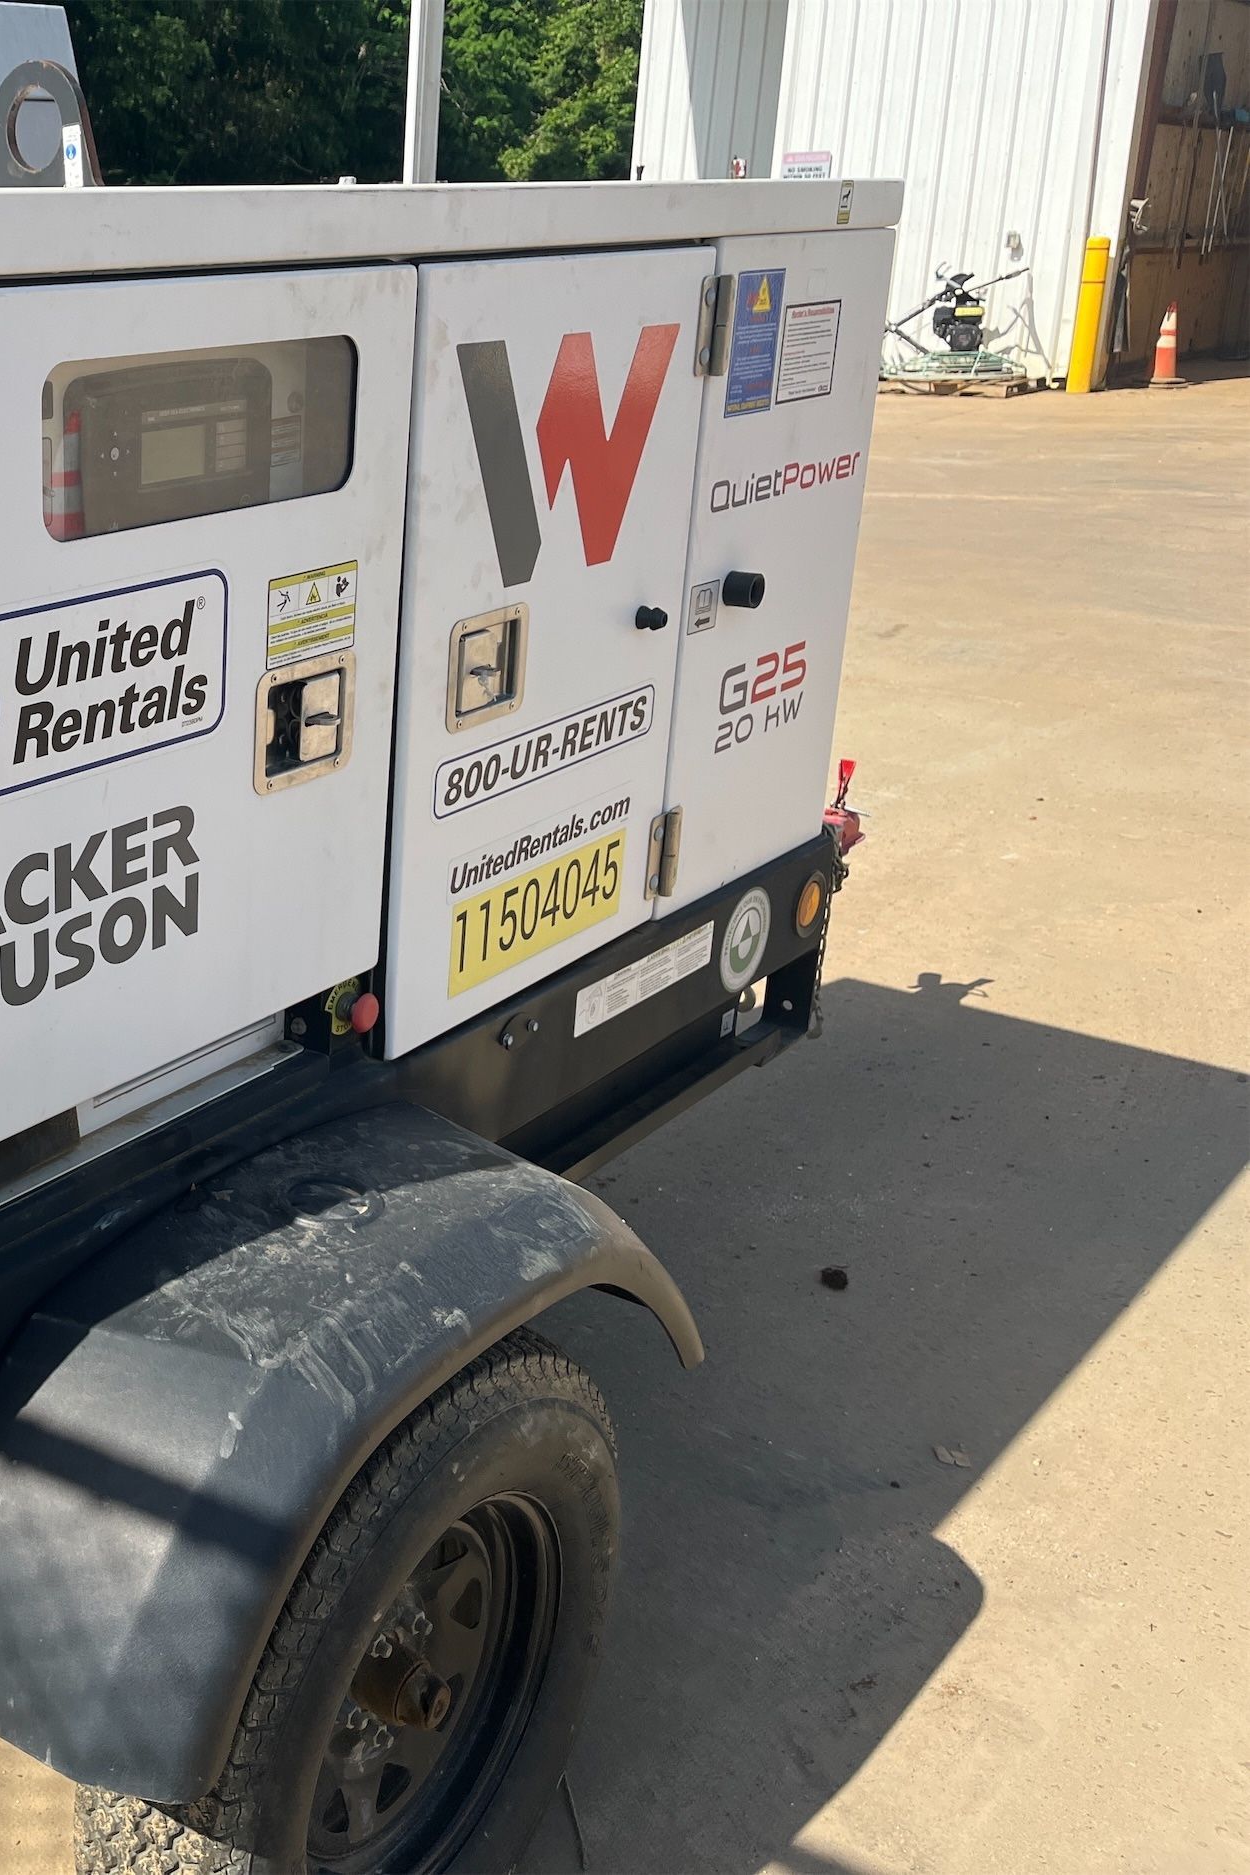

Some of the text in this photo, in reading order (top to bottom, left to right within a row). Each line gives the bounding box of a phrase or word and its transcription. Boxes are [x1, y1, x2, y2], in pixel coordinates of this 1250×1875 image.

[710, 451, 861, 513] QuietPower
[13, 599, 195, 697] United
[719, 640, 807, 716] G25
[12, 664, 208, 765] Rentals
[443, 695, 648, 807] 800-UR-RENTS
[714, 713, 754, 754] 20
[450, 795, 631, 896] UnitedRentals.com
[455, 838, 621, 974] 11504045
[328, 978, 357, 1010] EMERGEN
[335, 1023, 352, 1033] STO
